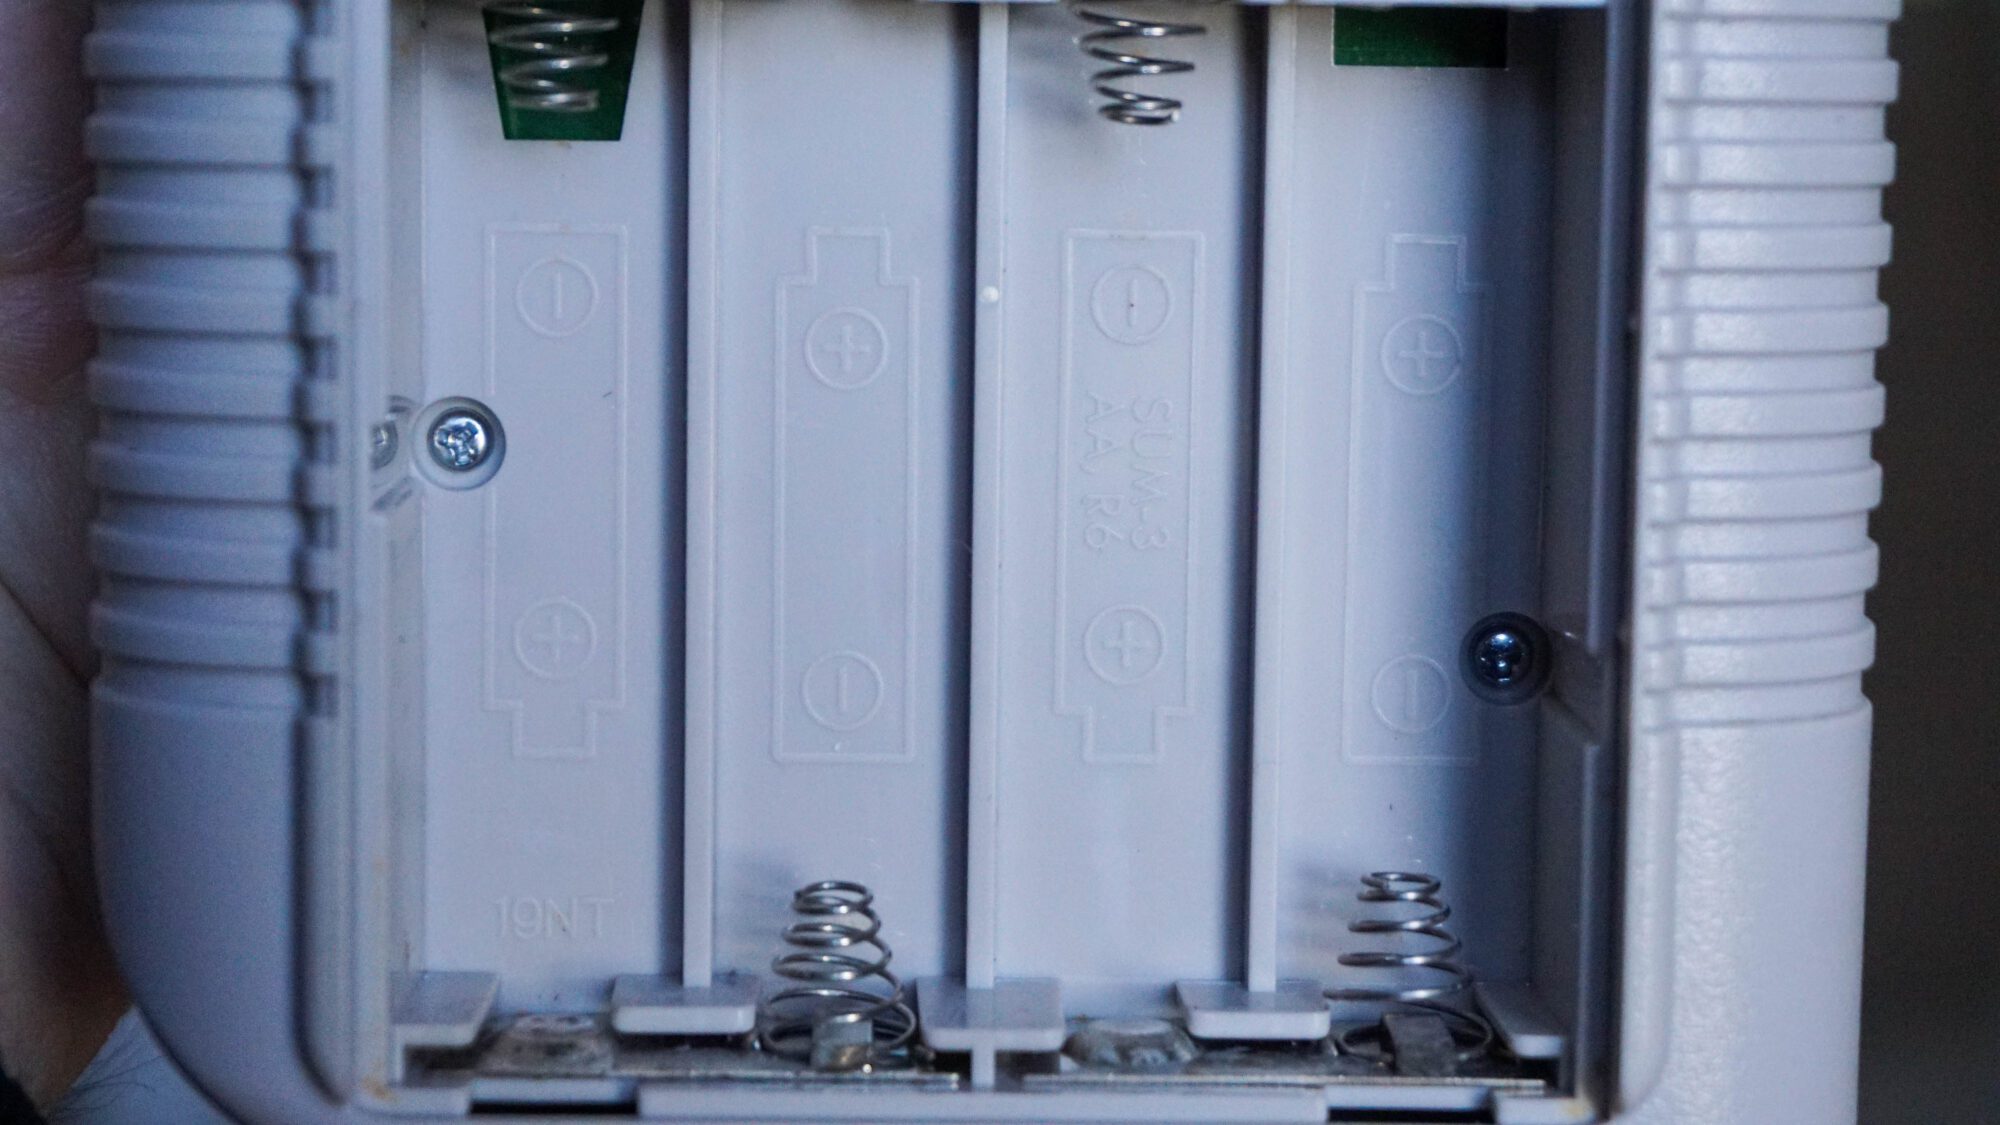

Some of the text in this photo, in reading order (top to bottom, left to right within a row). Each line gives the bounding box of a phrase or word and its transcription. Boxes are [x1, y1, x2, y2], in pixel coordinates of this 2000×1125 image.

[1129, 395, 1174, 550] SUM-3
[1080, 493, 1126, 550] R6
[495, 895, 616, 939] 19NT
